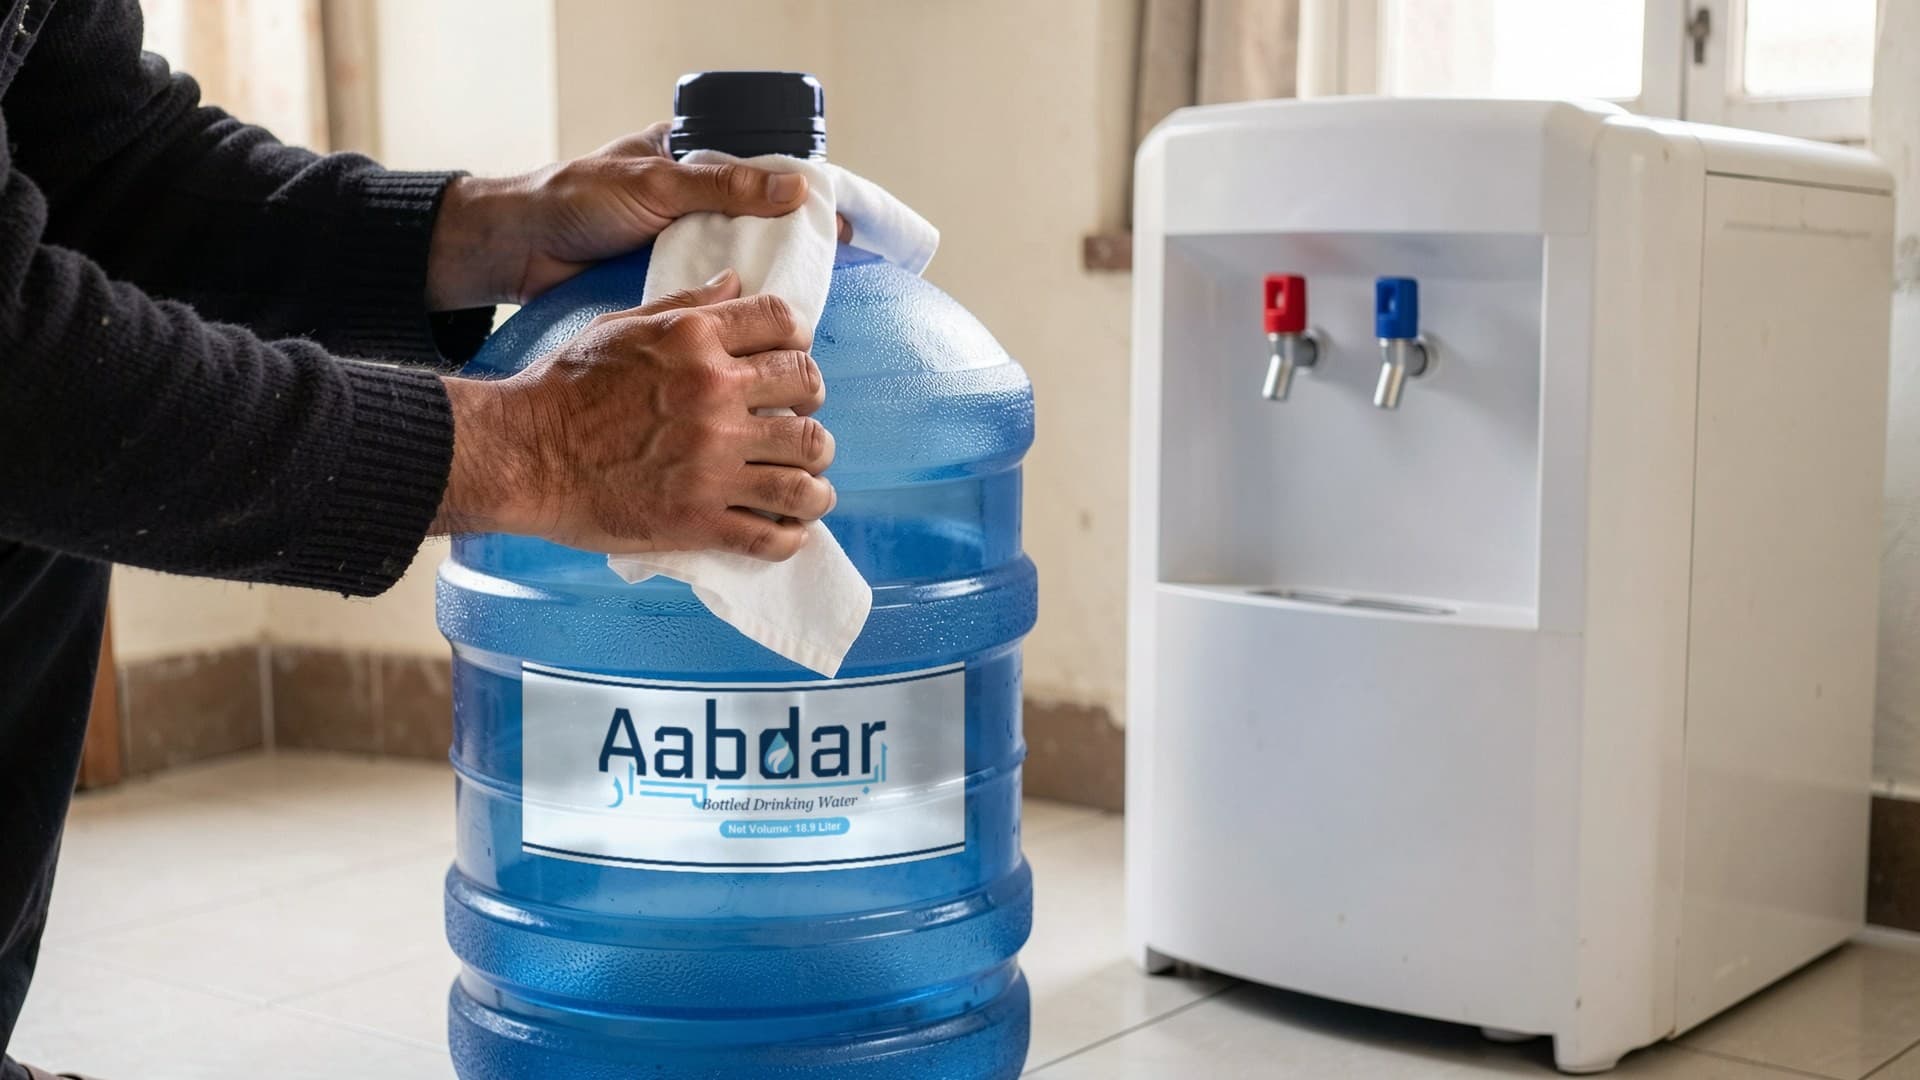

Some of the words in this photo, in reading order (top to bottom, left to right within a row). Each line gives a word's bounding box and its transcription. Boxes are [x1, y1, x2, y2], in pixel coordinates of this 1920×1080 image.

[599, 699, 887, 779] Aabdar
[702, 797, 750, 811] Bottled
[753, 797, 814, 813] Drinking
[818, 795, 858, 808] Water
[728, 824, 746, 834] Net
[750, 823, 792, 834] Volume:
[795, 822, 816, 833] 18.9
[818, 821, 842, 832] Liter
